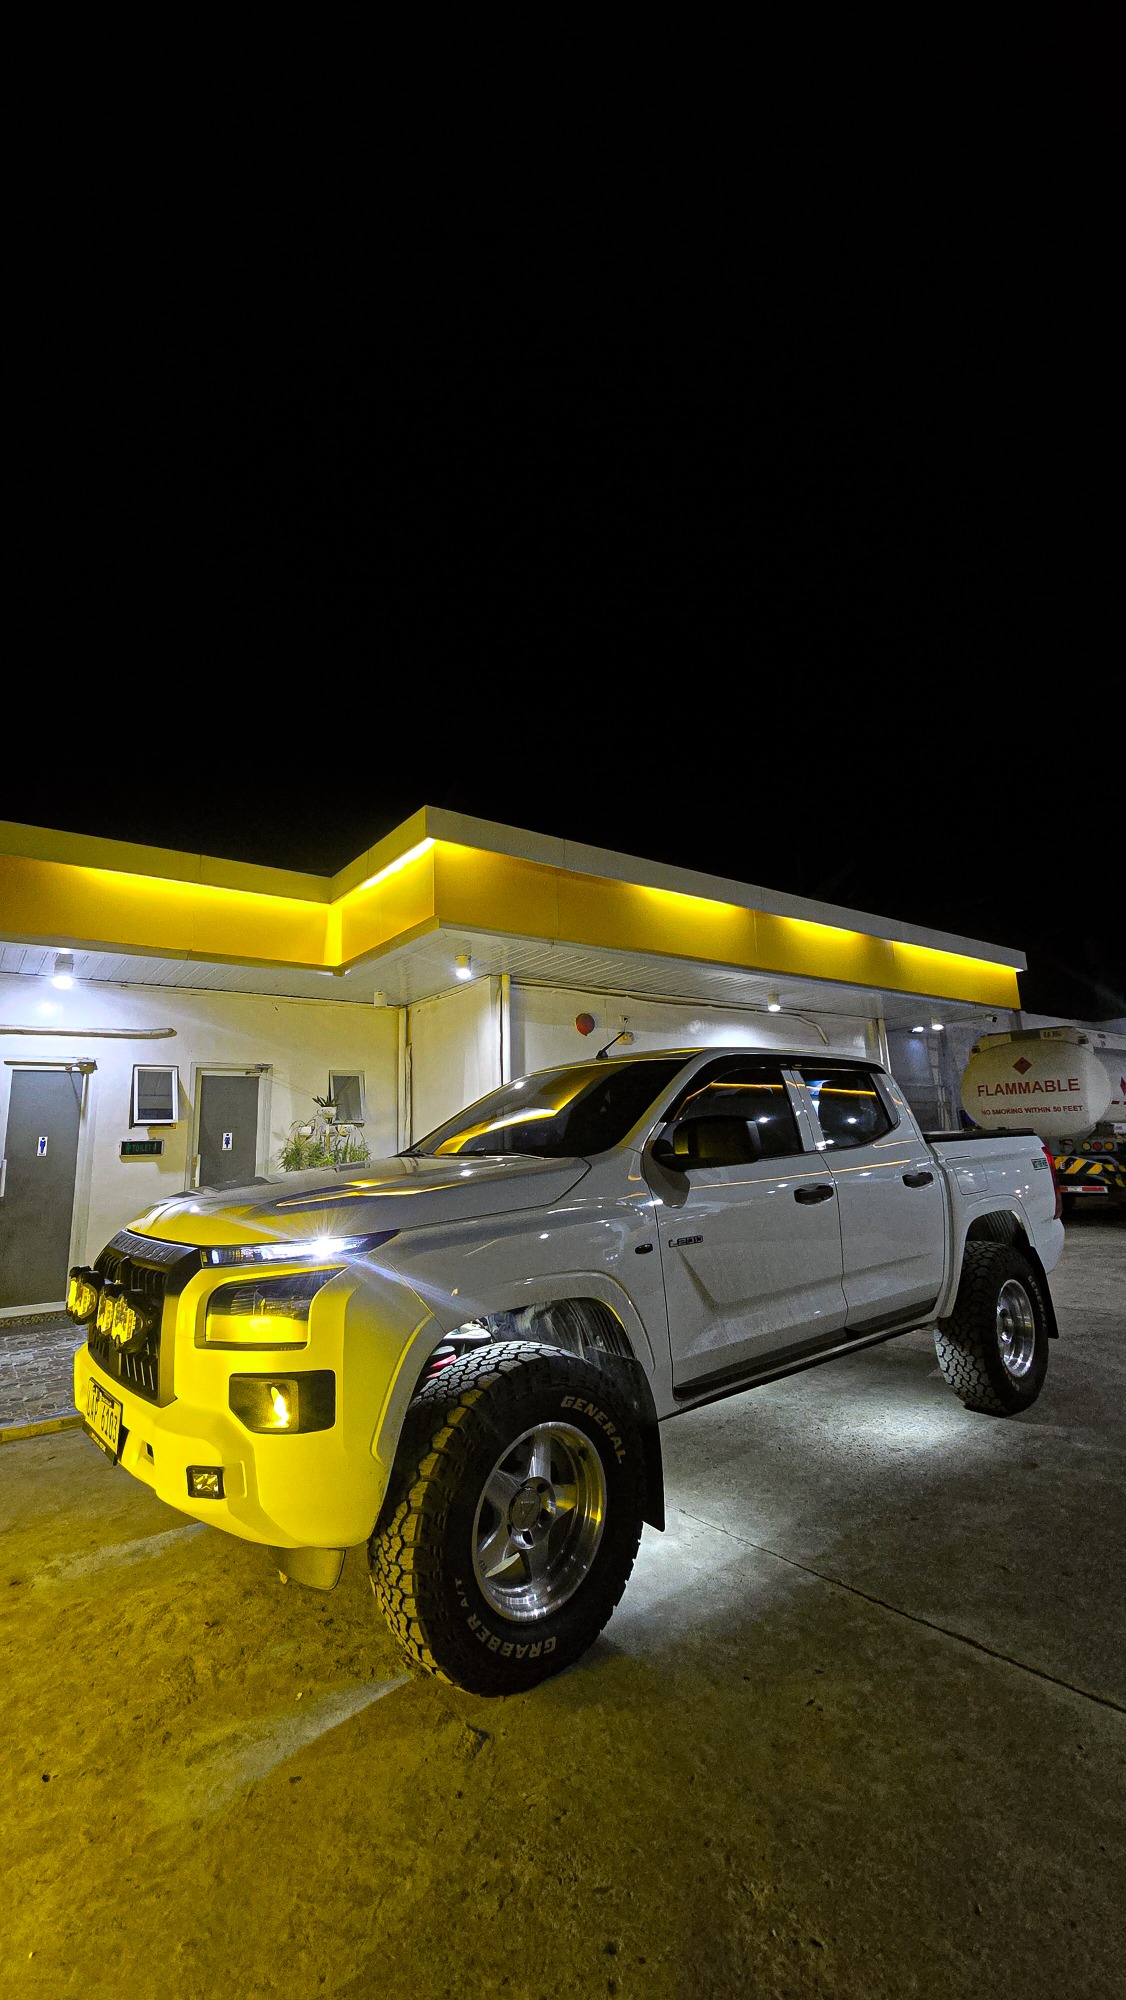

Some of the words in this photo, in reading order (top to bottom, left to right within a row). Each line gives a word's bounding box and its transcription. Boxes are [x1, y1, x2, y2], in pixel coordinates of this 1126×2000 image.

[977, 1078, 1080, 1097] FLAMMABLE
[991, 1107, 1023, 1116] SMOKING
[1024, 1106, 1051, 1114] WITHIN
[1052, 1105, 1062, 1113] 50
[1062, 1104, 1084, 1112] FEET
[560, 1394, 627, 1465] GENERAL
[466, 1611, 557, 1660] GRABBER
